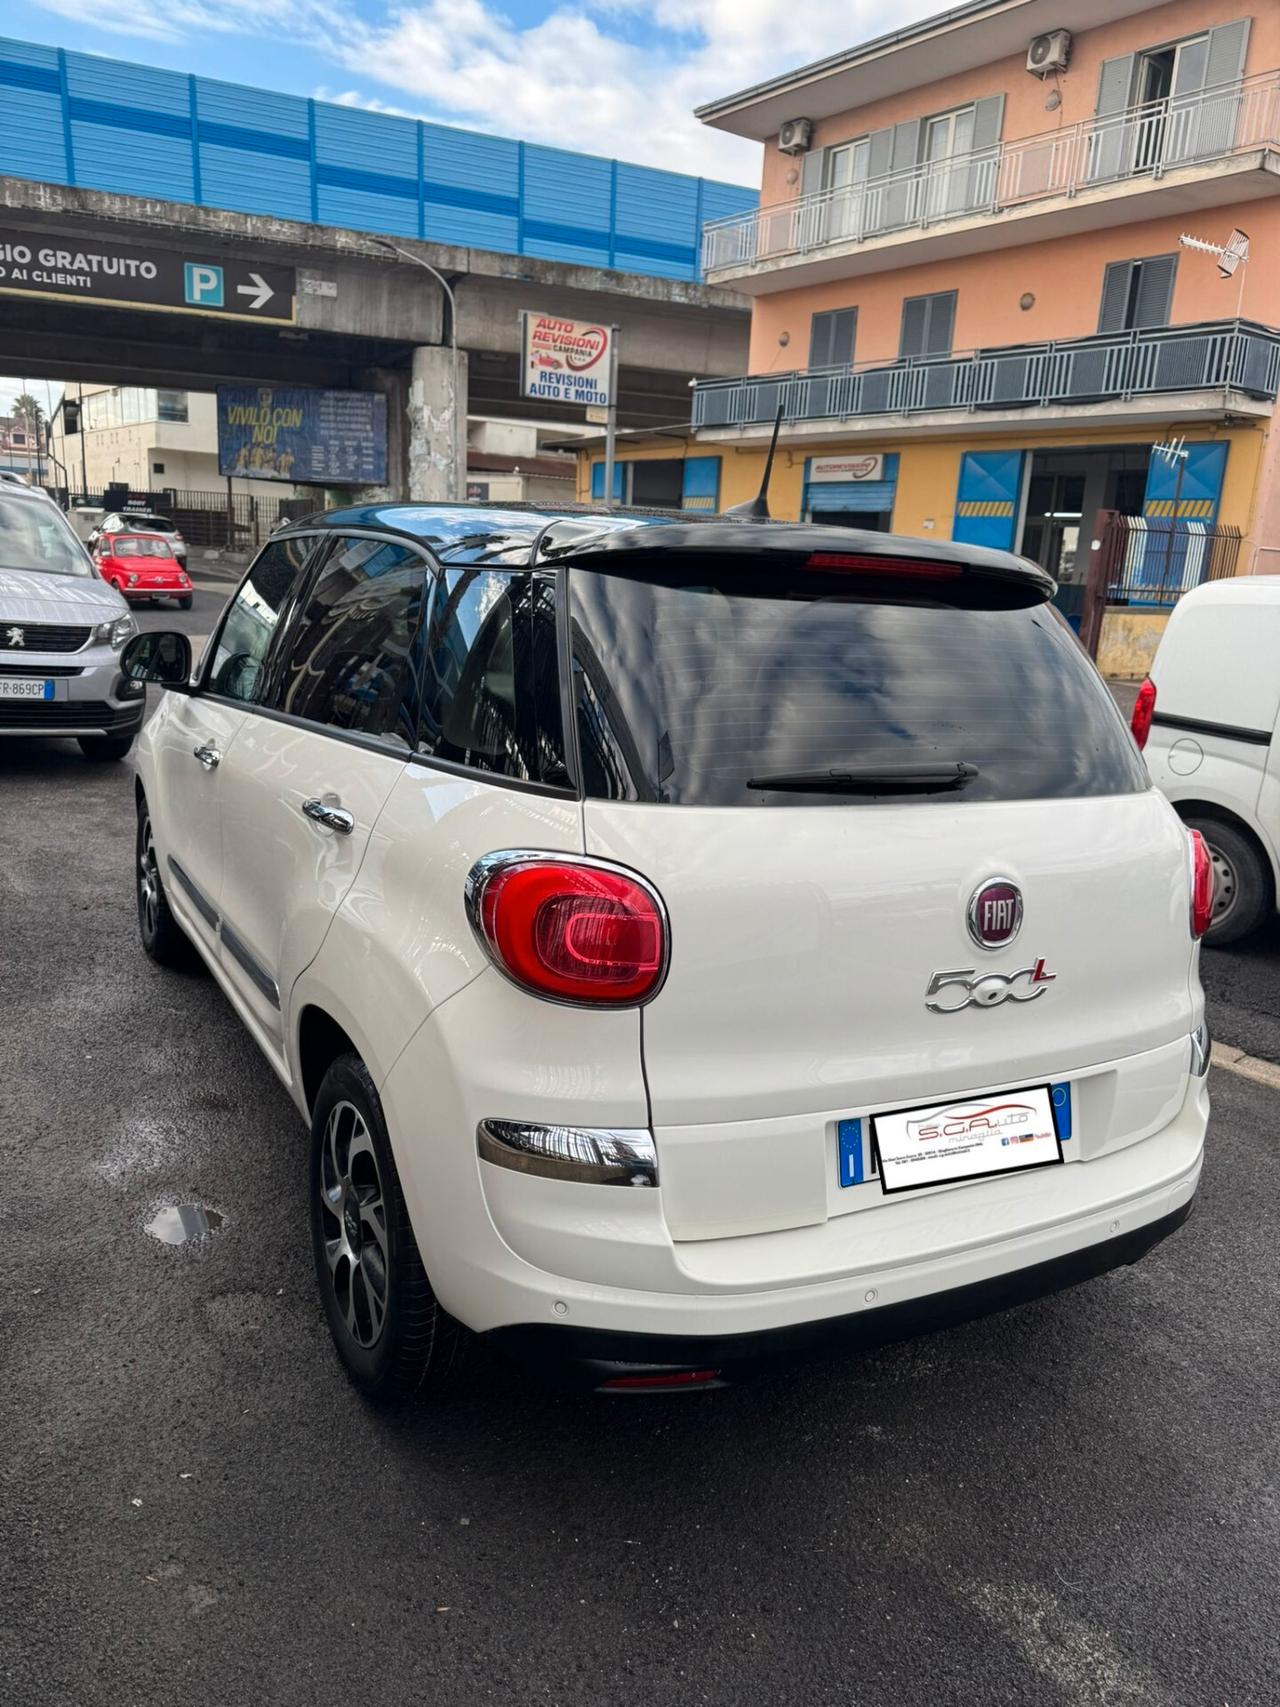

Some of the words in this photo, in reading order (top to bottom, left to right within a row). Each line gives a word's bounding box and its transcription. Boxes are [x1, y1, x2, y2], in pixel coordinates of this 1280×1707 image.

[38, 248, 158, 280] GRATUITO
[11, 268, 28, 280] AI
[32, 270, 91, 288] CLIENTI
[192, 267, 218, 301] P
[537, 319, 573, 333] AUTO
[533, 330, 600, 351] REVISIONI
[553, 344, 592, 357] CAMPANIA
[540, 371, 597, 390] REVISIONI
[530, 383, 559, 397] AUTO
[564, 388, 572, 399] E
[575, 388, 607, 404] MOTO
[228, 406, 272, 425] VIVILO
[273, 407, 303, 427] CON
[983, 899, 1014, 931] FIAT
